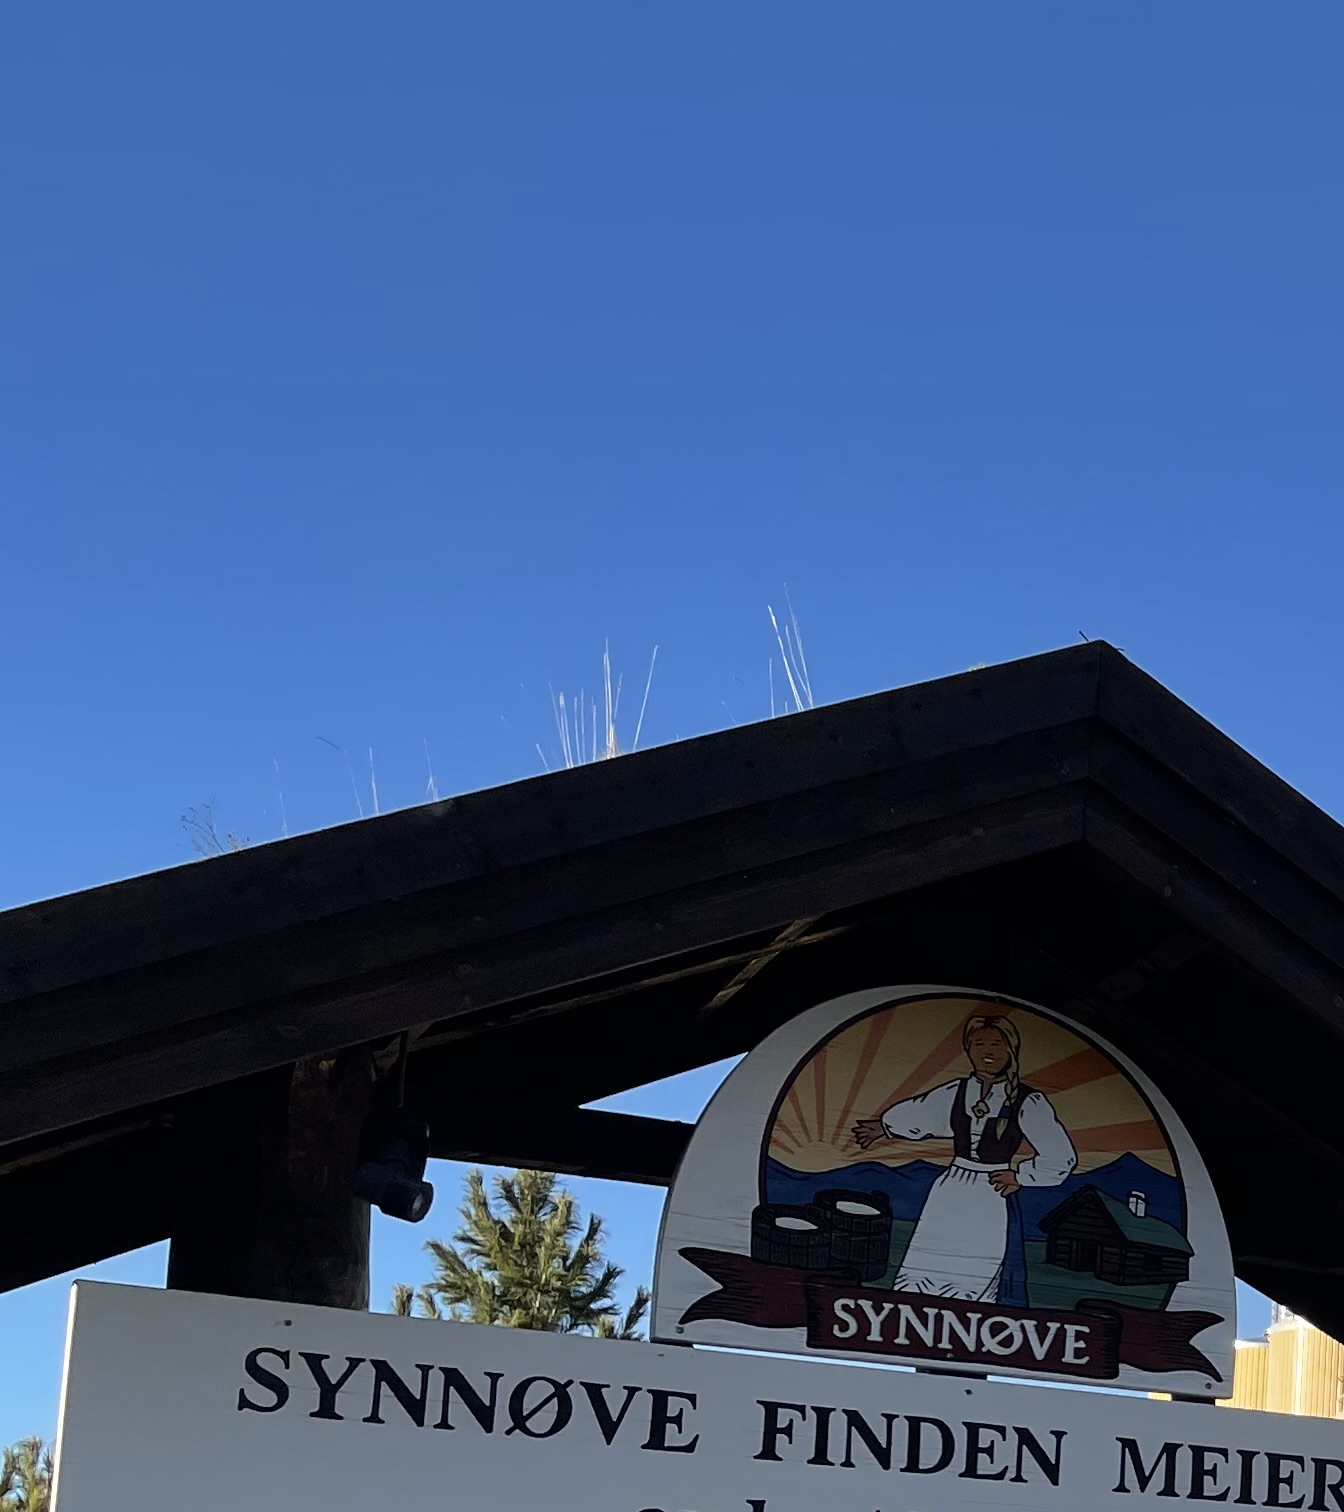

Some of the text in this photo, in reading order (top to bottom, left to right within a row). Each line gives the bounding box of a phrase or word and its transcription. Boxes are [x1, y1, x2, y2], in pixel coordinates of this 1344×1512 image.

[832, 1298, 1090, 1365] SYNNØVE
[236, 1347, 701, 1455] SYNNØVE
[752, 1399, 1068, 1487] FINDEN
